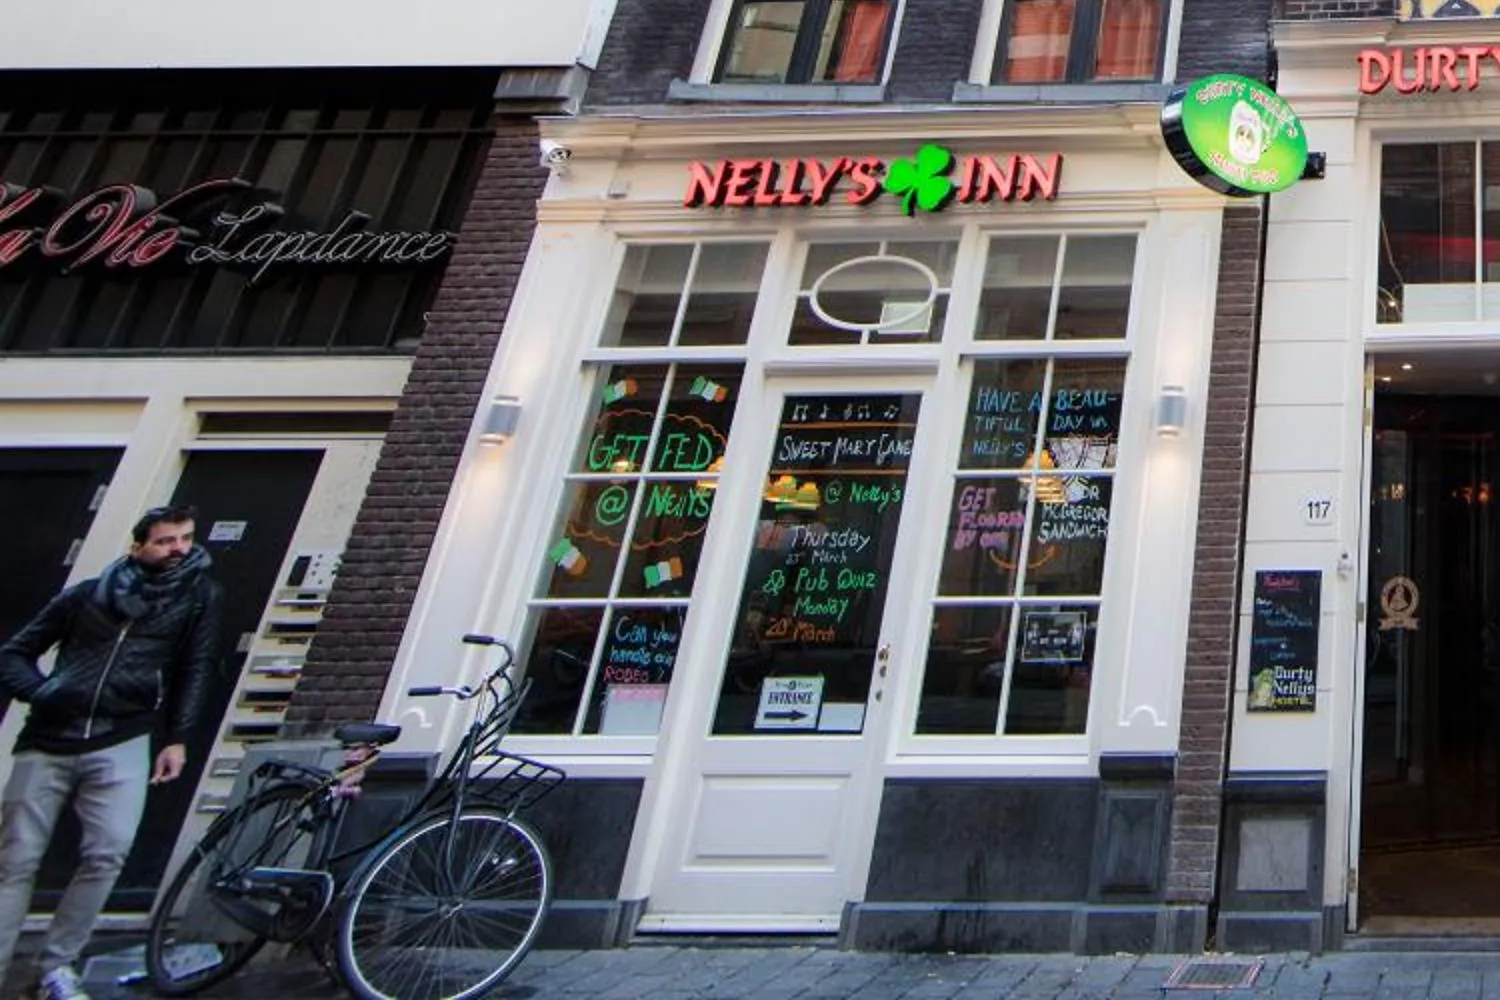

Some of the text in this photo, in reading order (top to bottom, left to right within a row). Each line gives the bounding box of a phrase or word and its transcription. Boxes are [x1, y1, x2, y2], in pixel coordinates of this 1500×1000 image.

[683, 151, 1062, 208] NELLY'S INN
[186, 202, 456, 287] Lapdance
[975, 385, 1023, 414] HAVE
[1027, 390, 1043, 413] A
[1053, 415, 1085, 431] DAY
[588, 432, 714, 471] GET FED
[778, 434, 832, 463] SWEET
[832, 436, 876, 466] MARY
[595, 485, 629, 526] @
[958, 484, 998, 512] GET
[1307, 500, 1331, 519] 117
[789, 525, 871, 553] Thursday
[794, 566, 878, 594] Pub Quiz
[615, 615, 647, 643] Can
